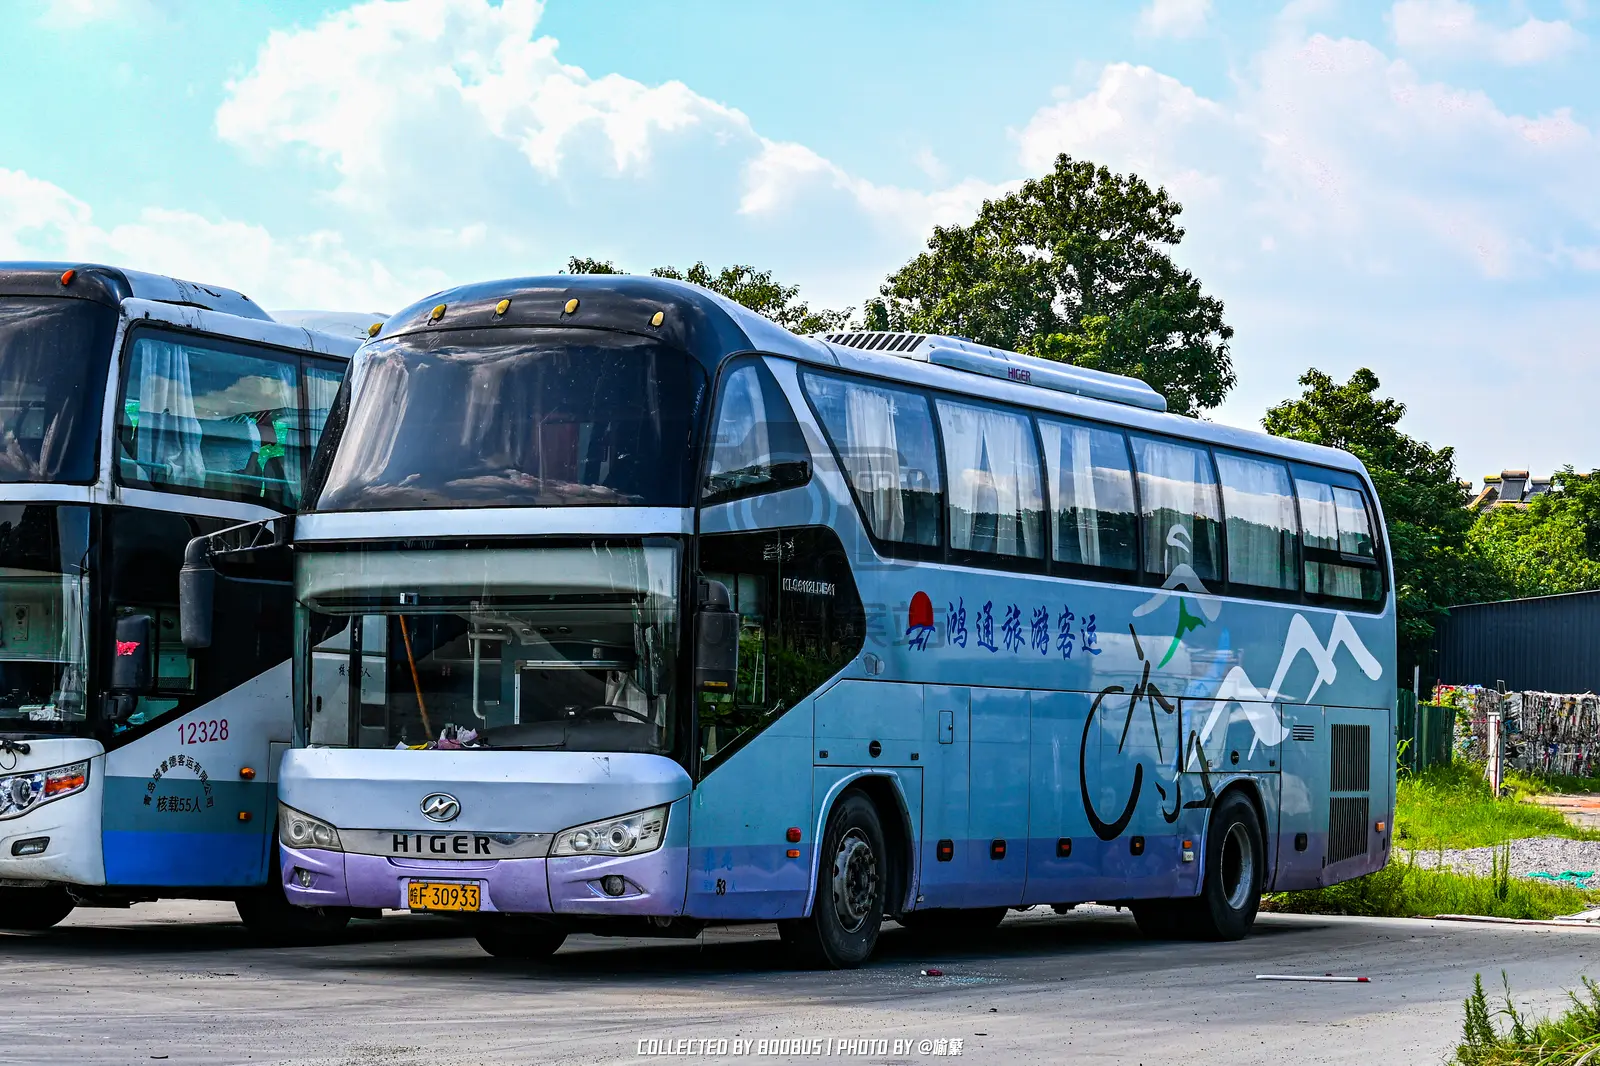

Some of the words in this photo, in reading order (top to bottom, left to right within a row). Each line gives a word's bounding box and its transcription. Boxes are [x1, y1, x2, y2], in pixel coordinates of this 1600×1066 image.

[1007, 367, 1031, 383] HIGER
[946, 596, 1102, 661] 鸿通旅游客运
[178, 718, 229, 745] 12328
[157, 795, 202, 813] 核载55人
[392, 833, 491, 855] HIGER
